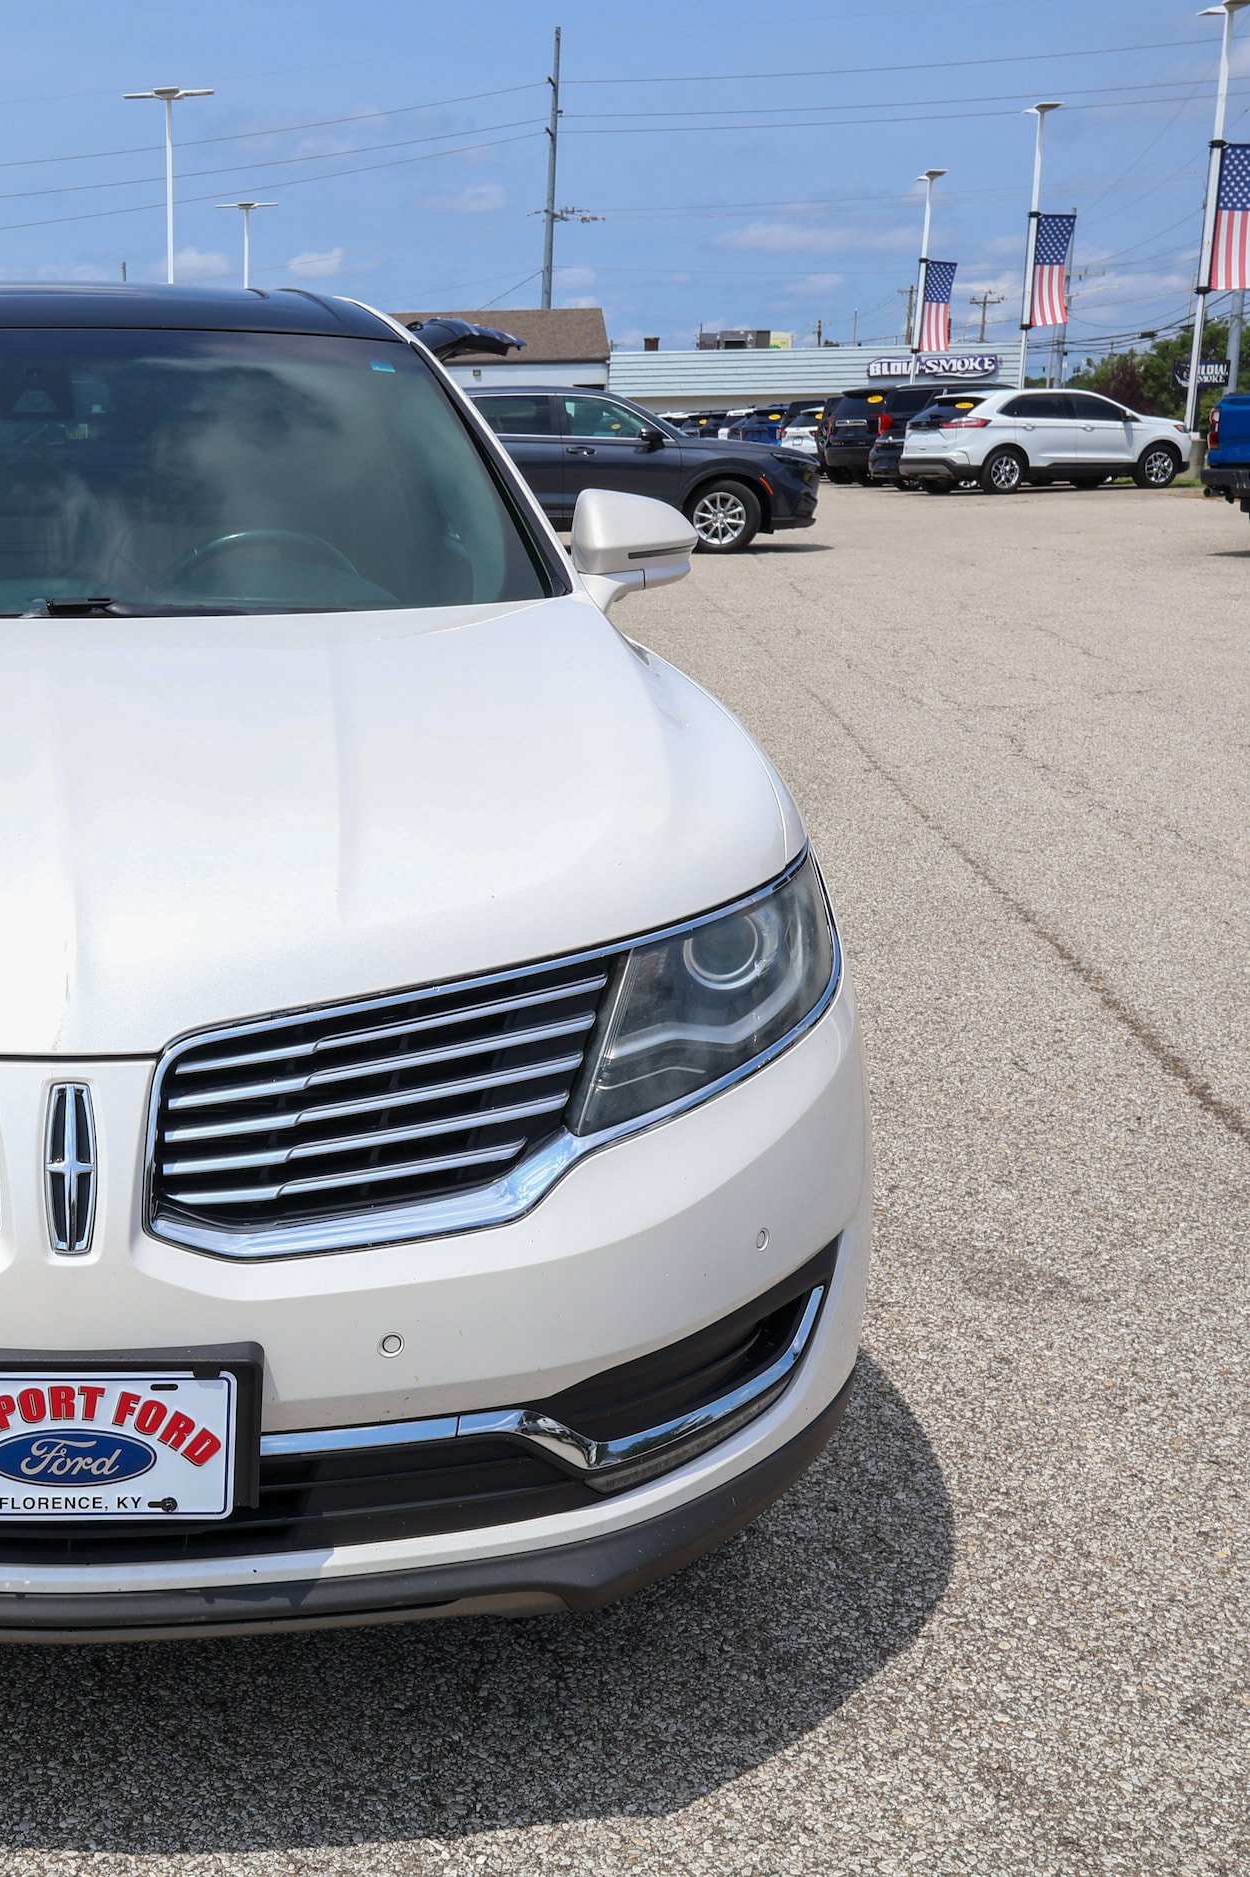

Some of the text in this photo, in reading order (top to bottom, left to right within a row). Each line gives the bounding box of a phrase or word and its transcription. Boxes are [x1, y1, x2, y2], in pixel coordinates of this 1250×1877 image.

[925, 356, 996, 374] SMOKE
[1197, 364, 1227, 375] LOW
[112, 1390, 223, 1467] FORD
[19, 1438, 123, 1476] Ford
[116, 1496, 142, 1510] KY
